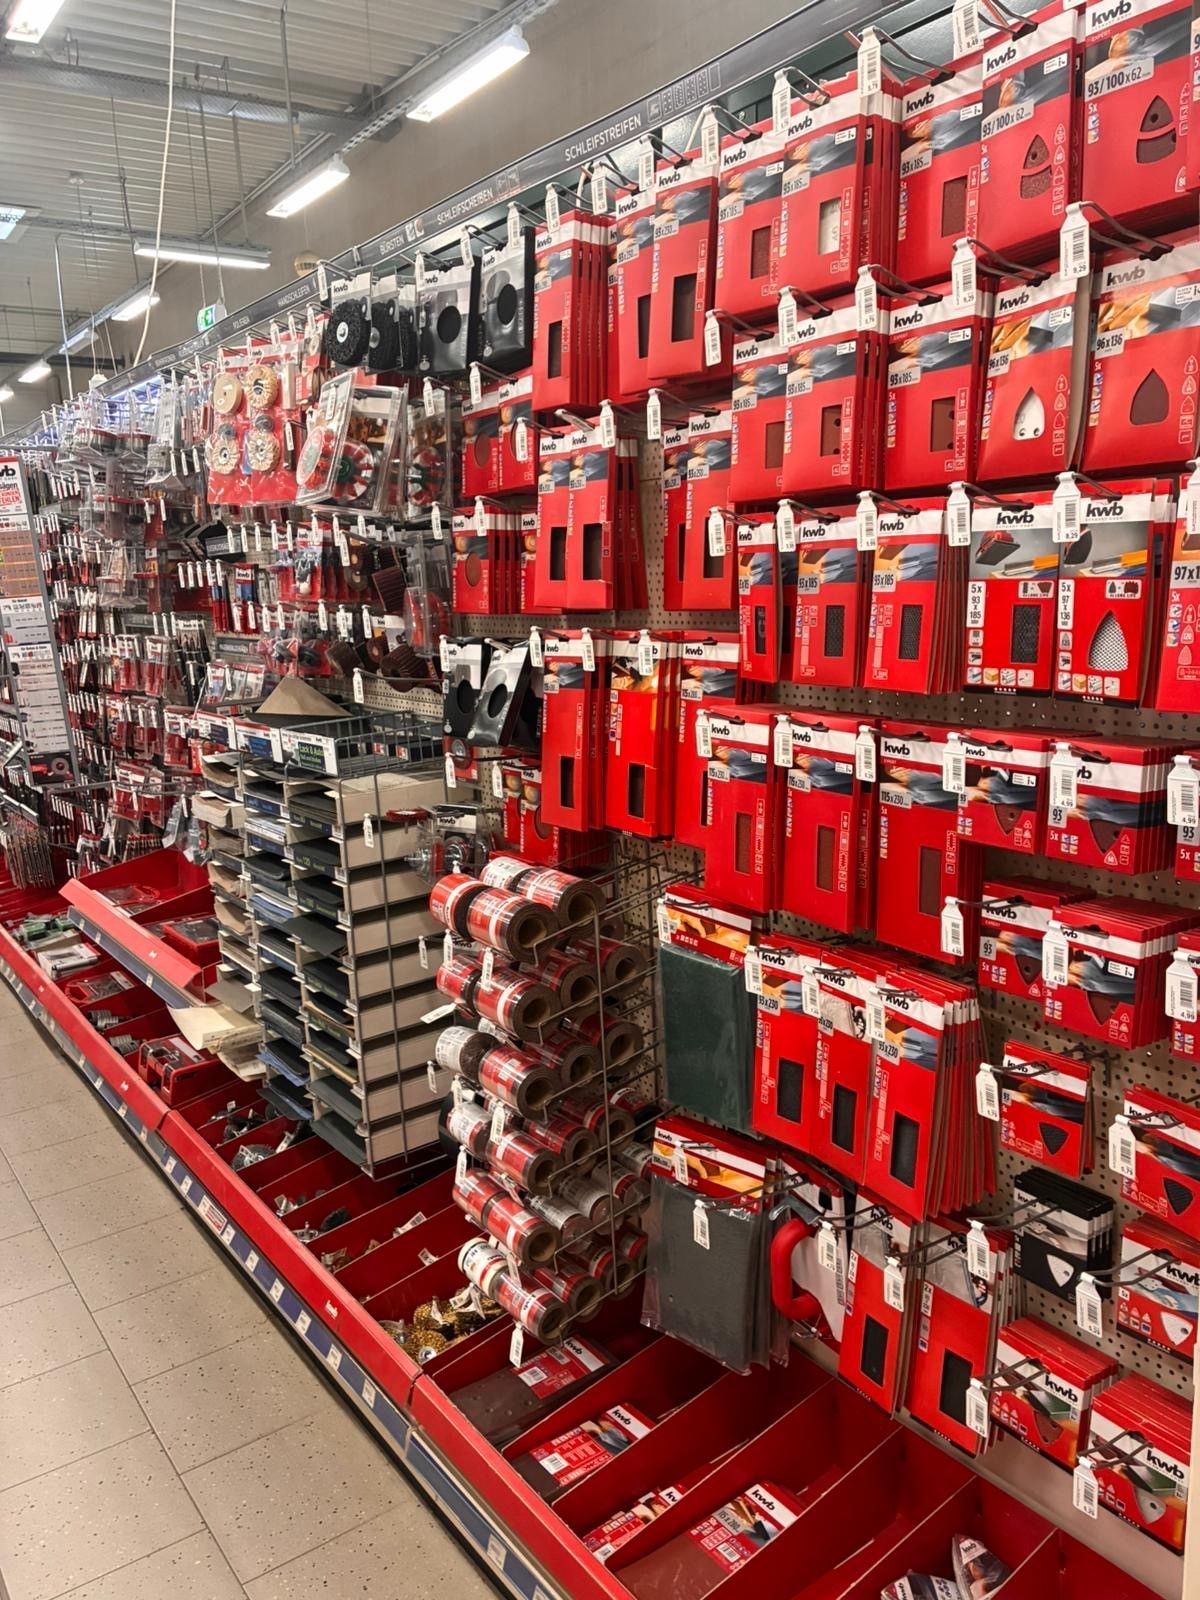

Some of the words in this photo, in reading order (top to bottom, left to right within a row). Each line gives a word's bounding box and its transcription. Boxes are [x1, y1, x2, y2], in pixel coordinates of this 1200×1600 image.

[1092, 1, 1132, 27] kwb
[986, 46, 1016, 72] kwb
[906, 92, 934, 114] kwb
[1088, 103, 1098, 114] 5x
[788, 116, 813, 137] kwb
[564, 114, 642, 162] SCHLEIFSTREIFEN
[724, 150, 747, 166] kwb
[659, 171, 680, 188] kwb
[437, 188, 494, 226] SCHLEIFSCHEIBEN
[618, 199, 638, 216] kwb
[380, 236, 405, 256] BÜRSTEN
[536, 236, 552, 249] kwb
[424, 275, 438, 286] wb
[1106, 265, 1145, 288] kwb
[334, 284, 348, 294] kwb
[1000, 291, 1030, 313] kwb
[894, 311, 924, 329] kwb
[796, 325, 816, 340] wb
[1096, 333, 1124, 352] 96x136
[736, 345, 758, 360] kwb
[890, 371, 913, 387] 93x185
[692, 420, 711, 432] kwb
[572, 434, 588, 447] kwb
[666, 431, 681, 444] kwb
[541, 440, 557, 454] kwb
[1086, 502, 1124, 518] kwb
[522, 516, 536, 527] kwb
[996, 511, 1034, 525] kwb
[802, 526, 826, 538] kwb
[880, 520, 904, 532] kwb
[738, 530, 752, 542] kwb
[972, 595, 981, 605] 93
[1062, 594, 1070, 604] 97
[1171, 591, 1180, 602] 5x
[970, 612, 982, 620] 185
[1060, 612, 1070, 620] 136
[546, 644, 559, 654] kwb
[685, 645, 704, 656] kwb
[712, 724, 730, 736] kwb
[792, 729, 812, 742] kwb
[884, 741, 911, 756] kwb
[966, 748, 985, 758] kwb
[880, 790, 904, 806] 115x230
[1052, 808, 1063, 821] 93
[1182, 816, 1196, 825] 4,99
[1050, 830, 1060, 842] 5x
[1183, 826, 1194, 839] 93
[1180, 849, 1191, 860] 5x
[982, 942, 992, 955] 93
[760, 954, 786, 966] kwb
[824, 972, 846, 988] kwb
[886, 994, 910, 1010] kwb
[1180, 1012, 1195, 1020] 4,99
[1045, 1376, 1078, 1403] kwb
[612, 1409, 632, 1428] kwb
[1146, 1450, 1185, 1480] kwb
[751, 1488, 776, 1512] kwb
[962, 1542, 977, 1553] kwb
